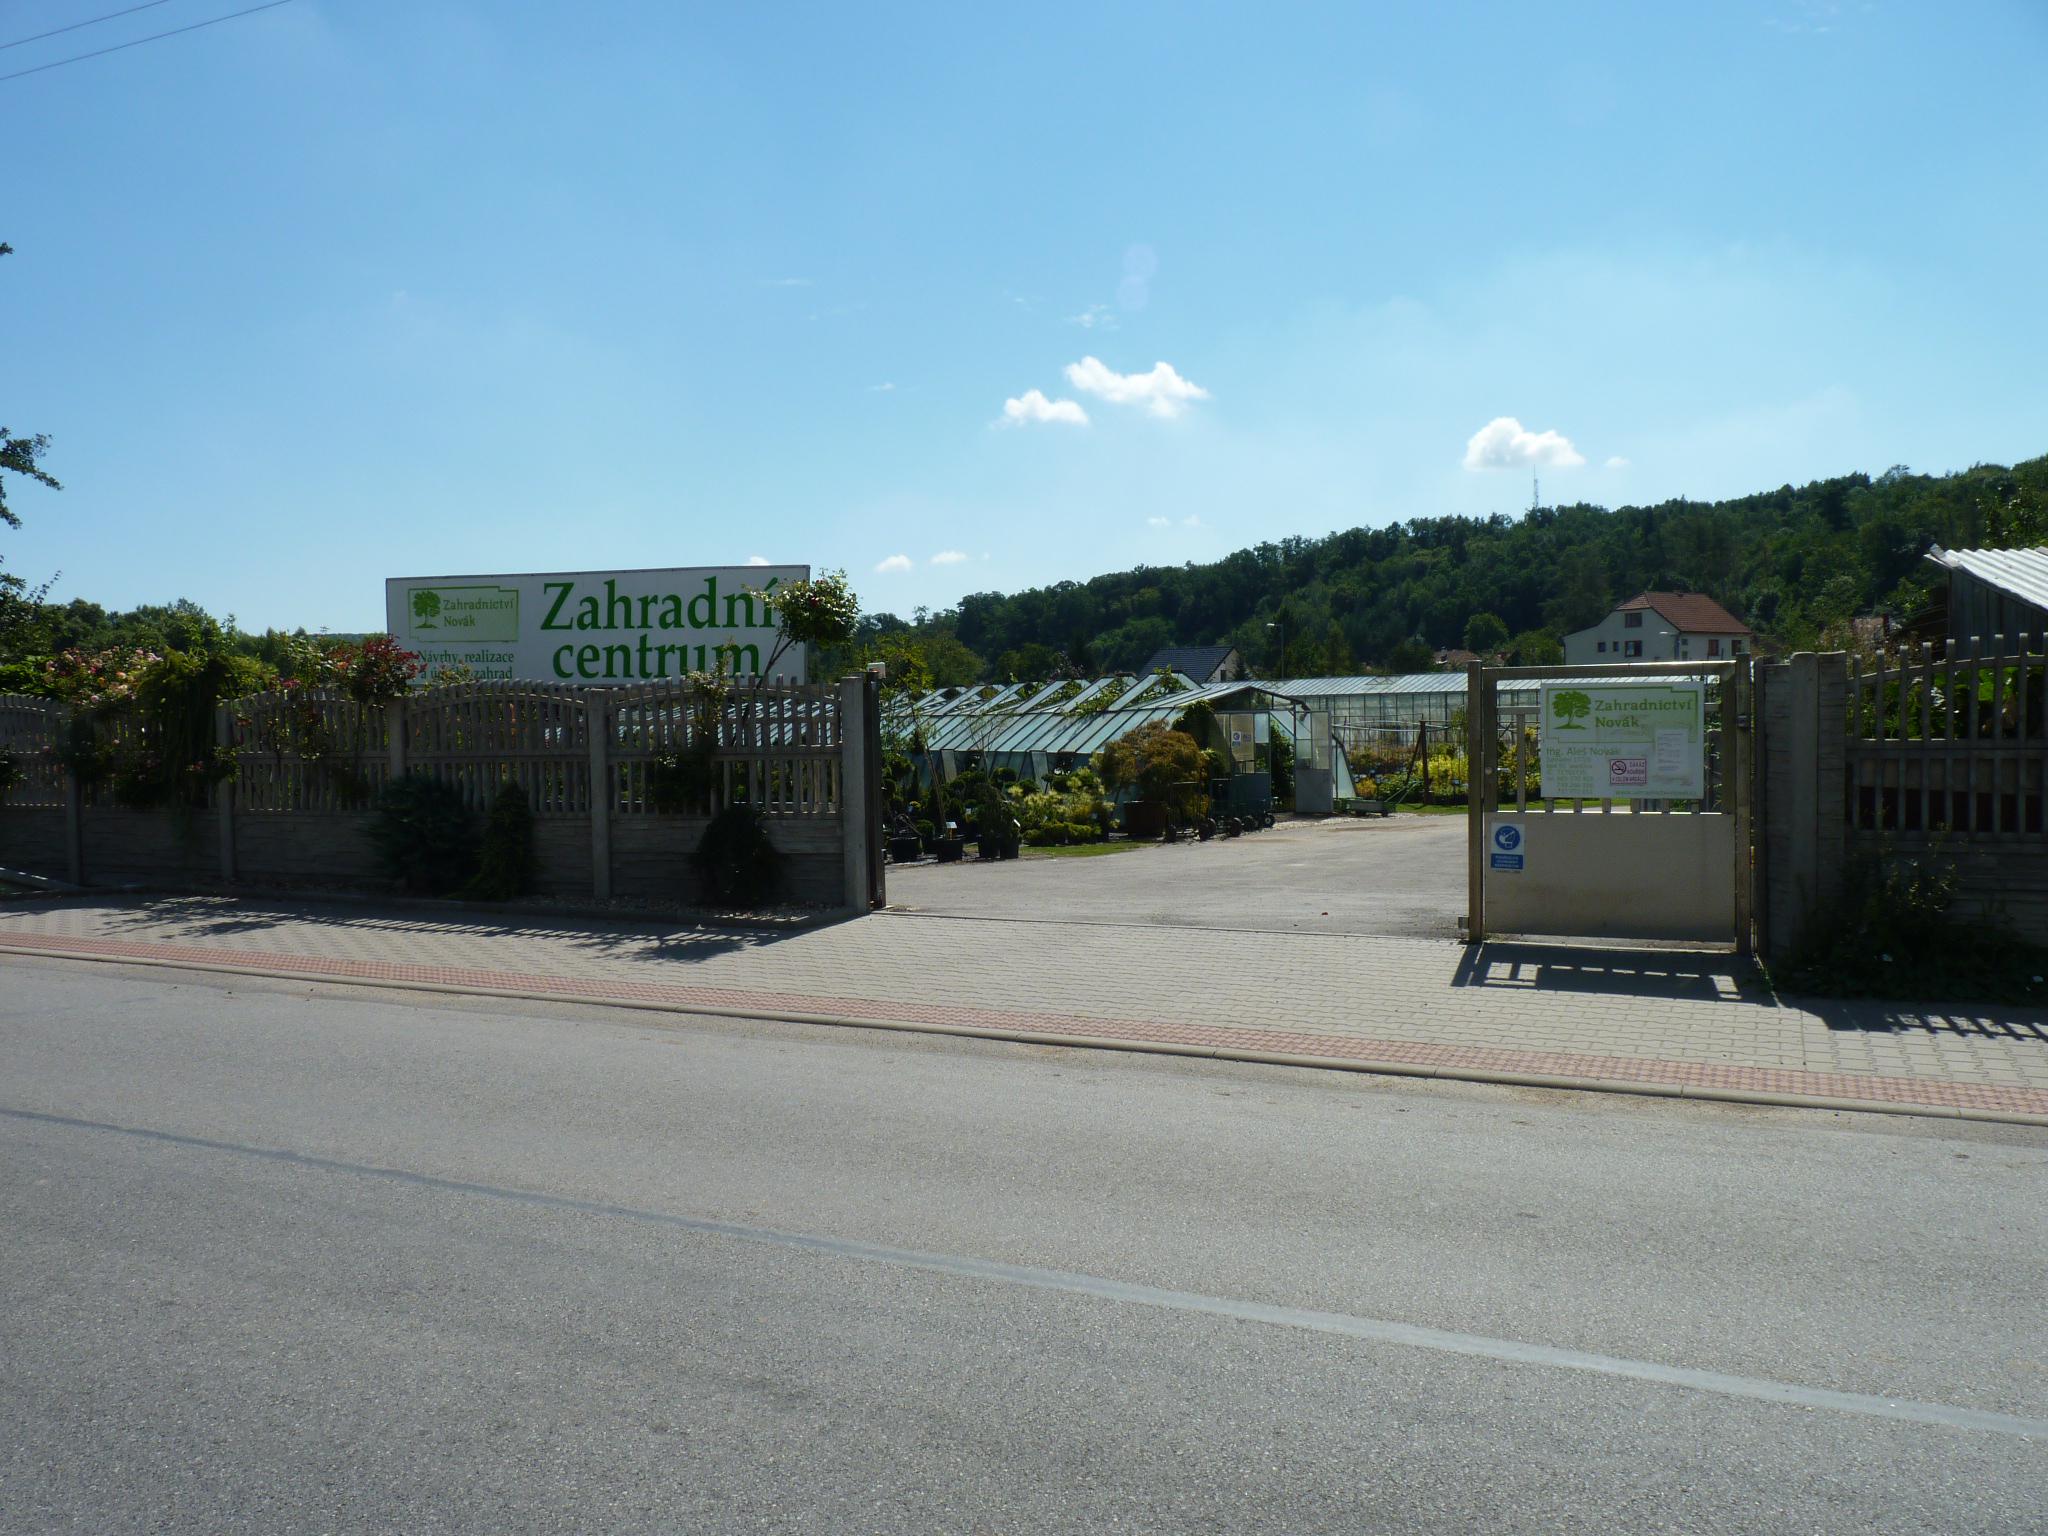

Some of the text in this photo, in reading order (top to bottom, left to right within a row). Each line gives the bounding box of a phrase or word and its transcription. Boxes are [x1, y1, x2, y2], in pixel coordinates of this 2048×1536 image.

[443, 597, 514, 611] Zahradnictví
[540, 575, 779, 631] Zahradní
[443, 615, 476, 627] Novák
[465, 649, 514, 663] realizace
[552, 633, 765, 680] centrum
[474, 666, 513, 680] zahrad
[1595, 697, 1692, 711] Zahradnictví
[1595, 714, 1640, 728] Novák
